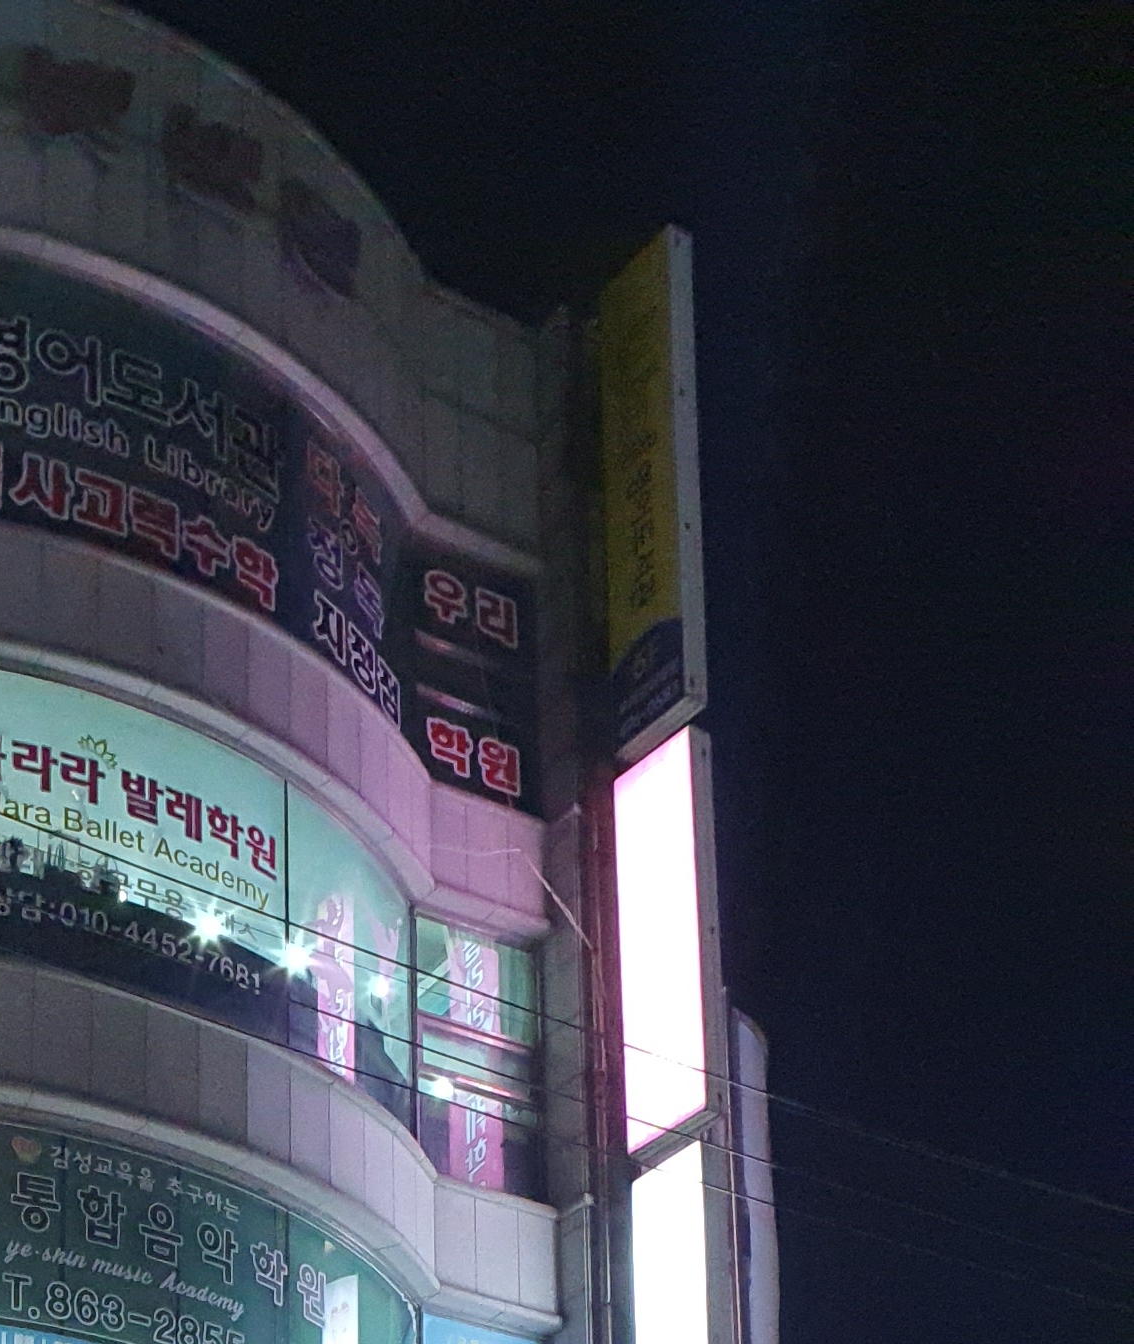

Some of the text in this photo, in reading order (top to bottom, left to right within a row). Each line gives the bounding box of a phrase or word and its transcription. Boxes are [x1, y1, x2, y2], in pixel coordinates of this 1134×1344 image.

[313, 589, 401, 731] 지정점
[424, 569, 518, 649] 우리
[426, 716, 521, 796] 학원
[63, 806, 144, 854] Ballet
[154, 841, 271, 910] Academy
[121, 768, 277, 881] 발레학원
